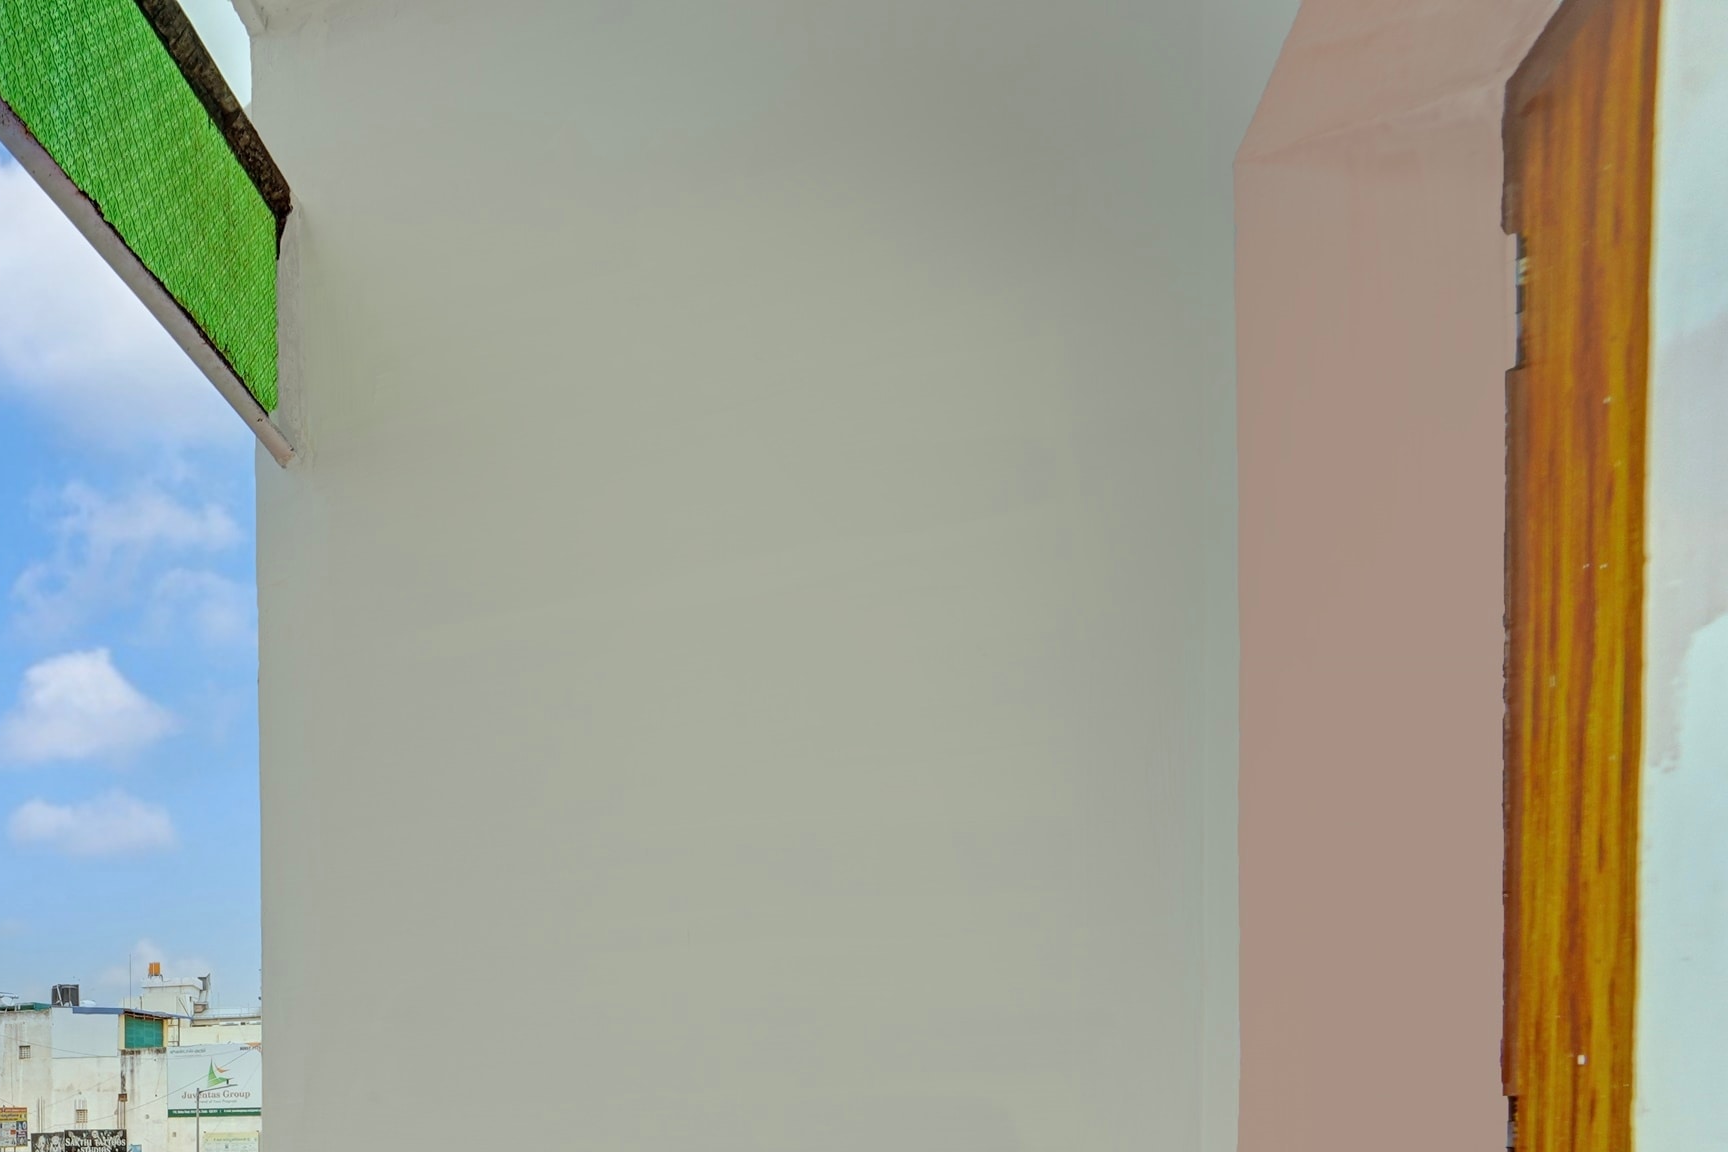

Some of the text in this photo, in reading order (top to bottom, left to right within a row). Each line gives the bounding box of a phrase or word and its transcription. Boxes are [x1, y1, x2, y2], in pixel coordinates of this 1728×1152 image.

[181, 1089, 251, 1100] Juventas Group
[65, 1136, 126, 1149] SAKTHI TATTOOS
